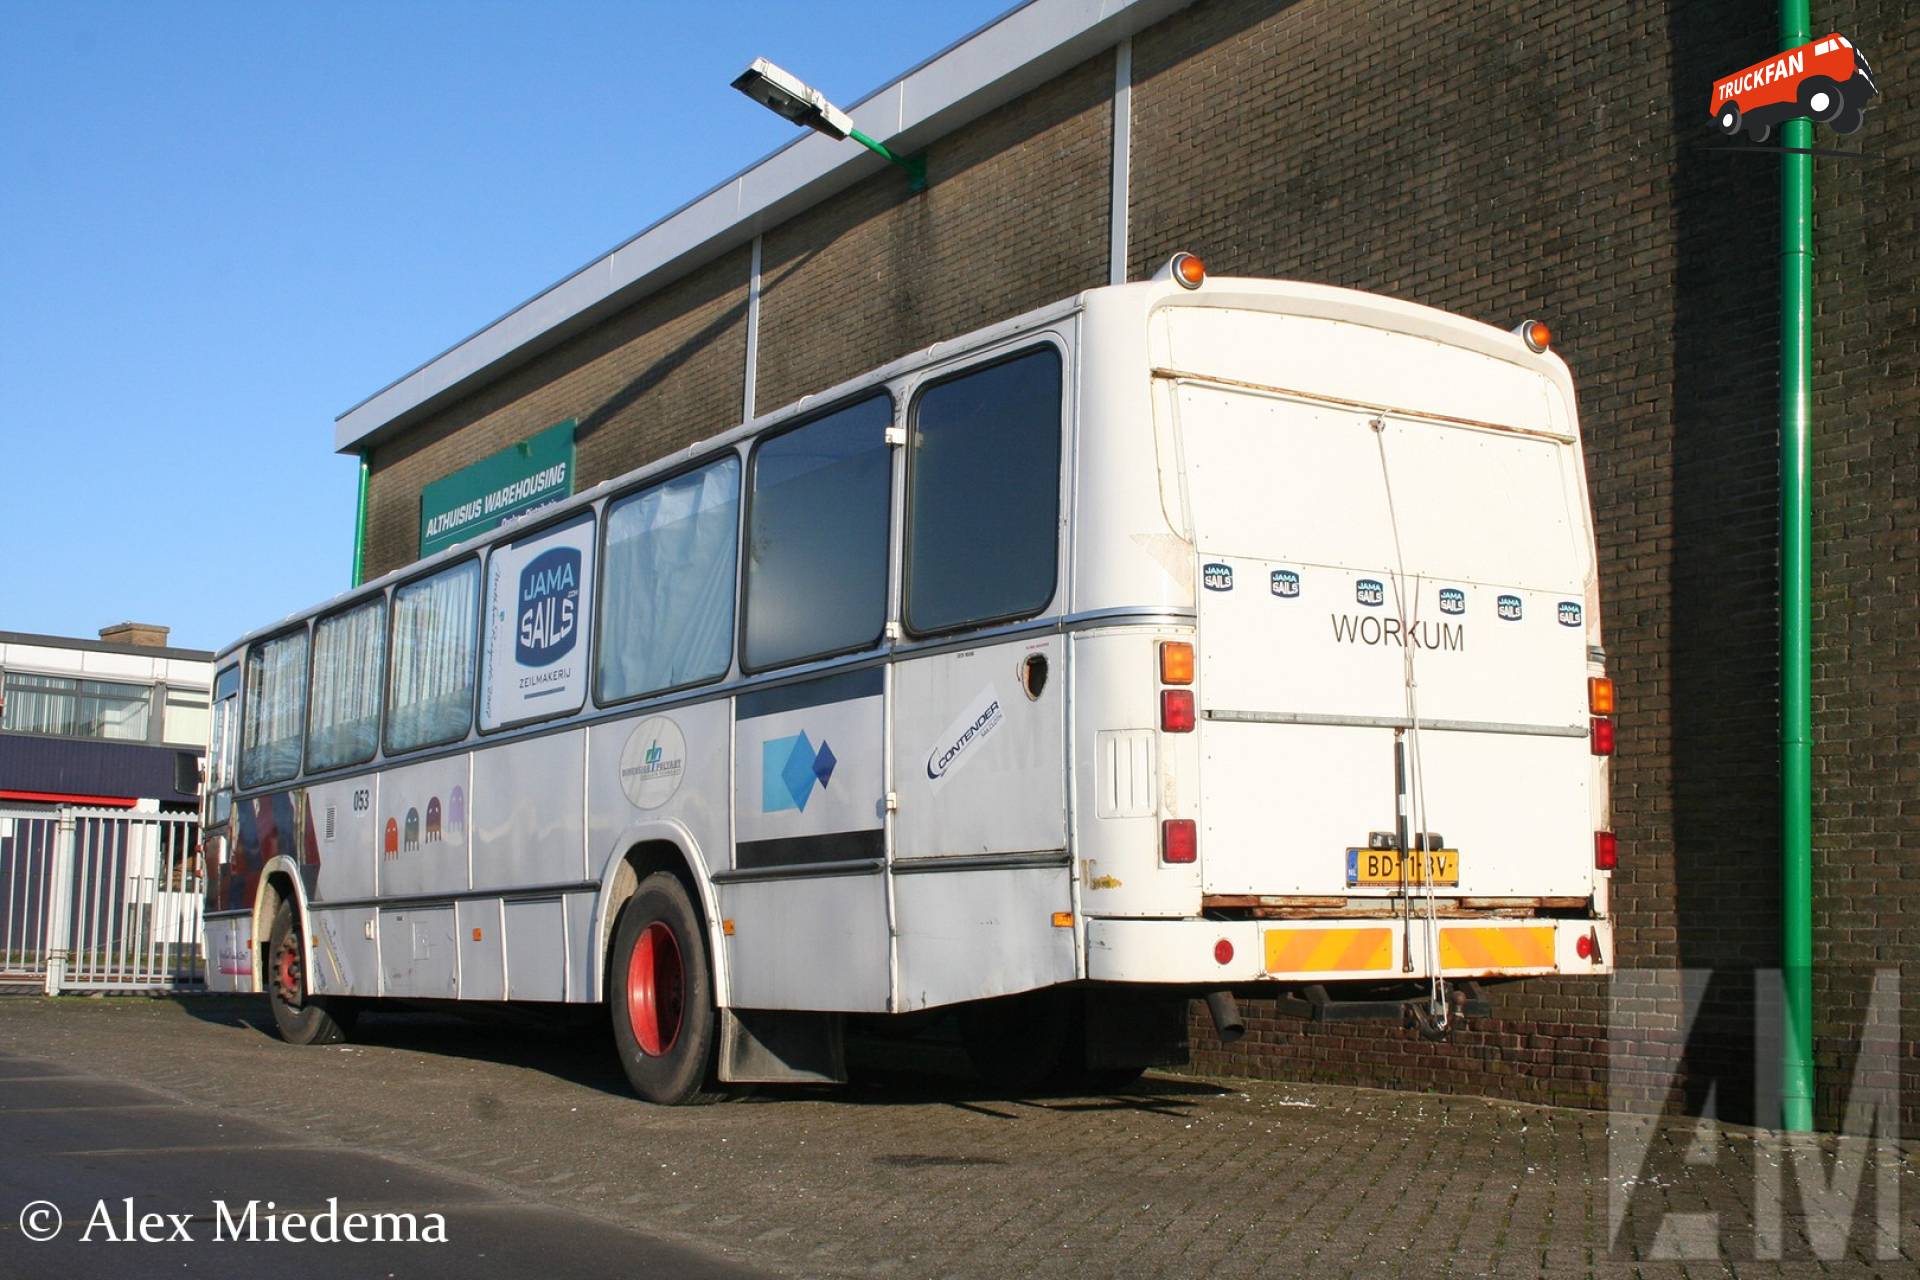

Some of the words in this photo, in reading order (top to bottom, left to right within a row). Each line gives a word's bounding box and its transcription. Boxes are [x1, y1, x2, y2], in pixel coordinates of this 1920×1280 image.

[426, 498, 482, 538] ALTHUISIUS
[484, 462, 566, 514] WAREHOUSING
[1205, 567, 1230, 576] JAMA
[1272, 573, 1297, 582] JAMA
[524, 562, 575, 601] JAMA
[1204, 575, 1232, 588] SAILS
[1272, 581, 1298, 595] SAILS
[1357, 582, 1381, 591] JAMA
[1357, 590, 1383, 603] SAILS
[1440, 592, 1462, 600] JAMA
[1440, 599, 1464, 611] SAILS
[1559, 604, 1579, 613] JAMA
[520, 597, 574, 649] SAILS
[1559, 612, 1581, 624] SAILS
[1331, 613, 1464, 652] WORKUM
[519, 667, 572, 689] ZEILMAKERIJ
[938, 701, 999, 769] CONTENDER
[353, 789, 370, 812] 053
